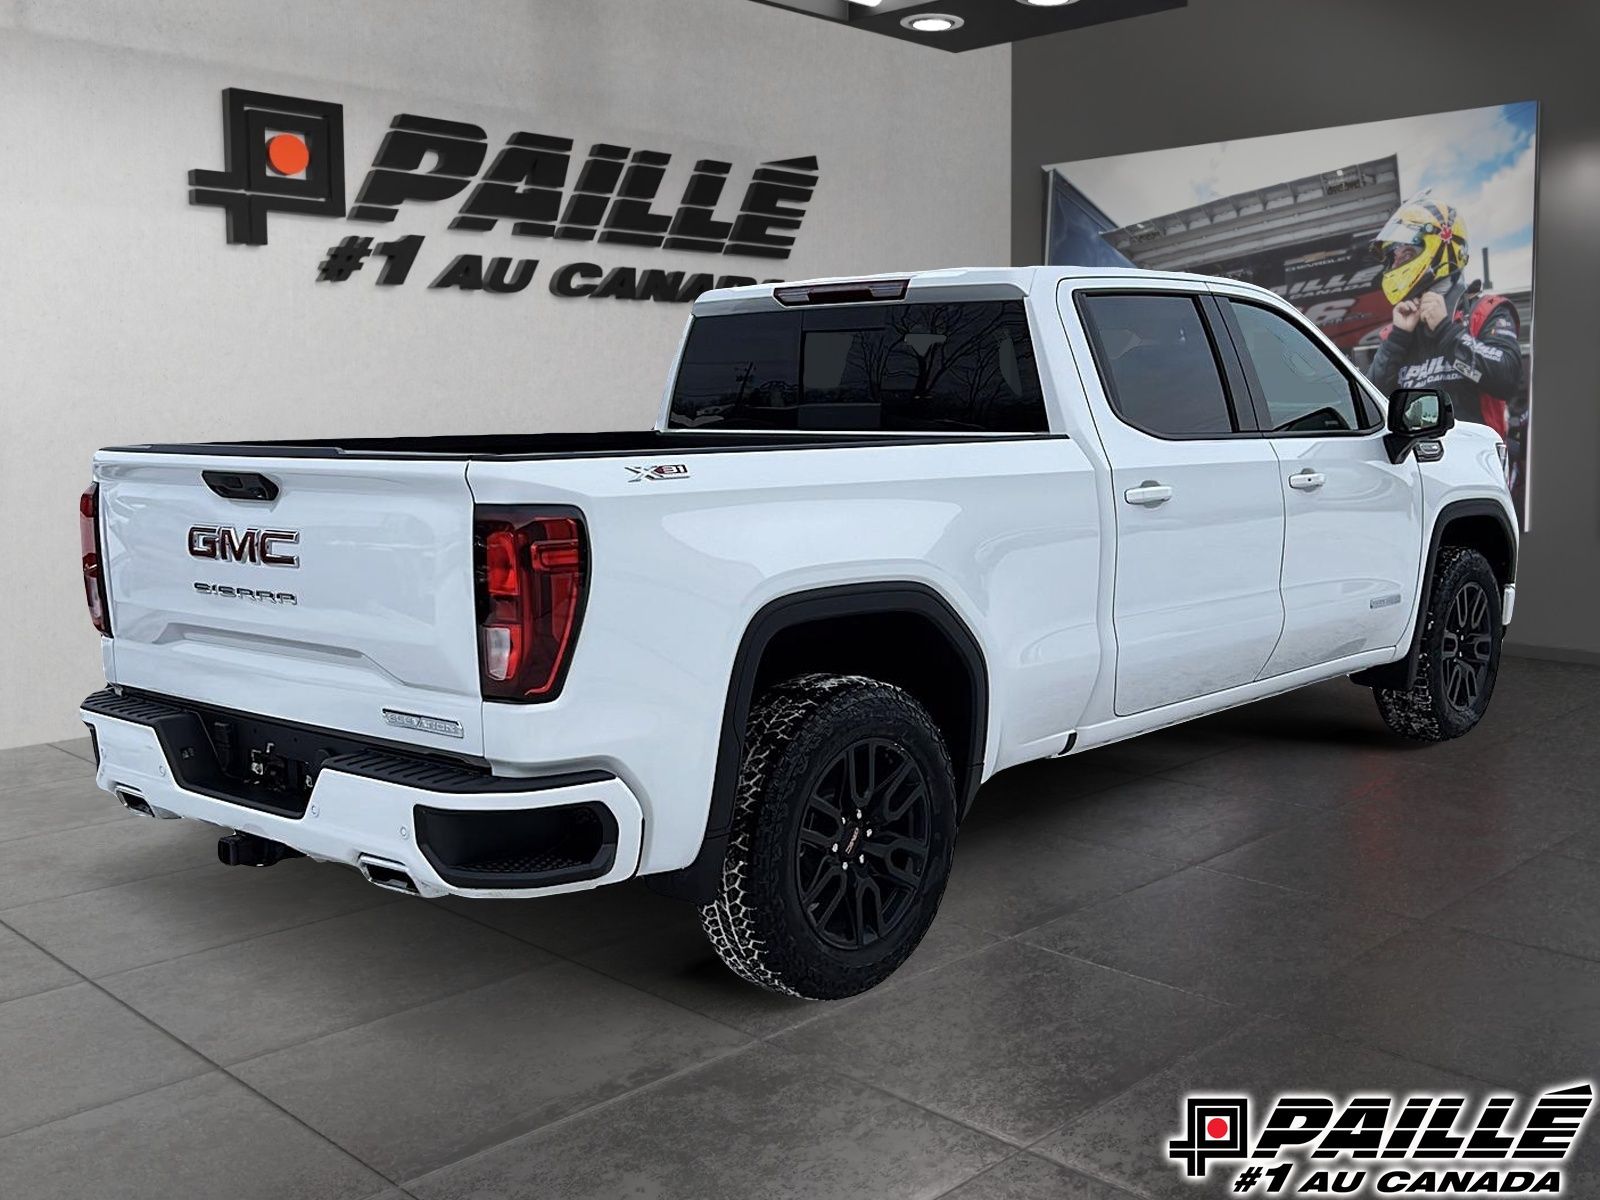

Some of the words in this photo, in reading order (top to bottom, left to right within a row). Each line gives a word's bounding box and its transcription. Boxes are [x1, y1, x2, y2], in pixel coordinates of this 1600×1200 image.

[347, 113, 818, 259] PAILLÉ
[316, 234, 425, 286] #1
[428, 254, 539, 294] AU
[549, 262, 785, 302] CANA
[187, 524, 300, 569] GMC
[193, 582, 298, 605] SIERRA
